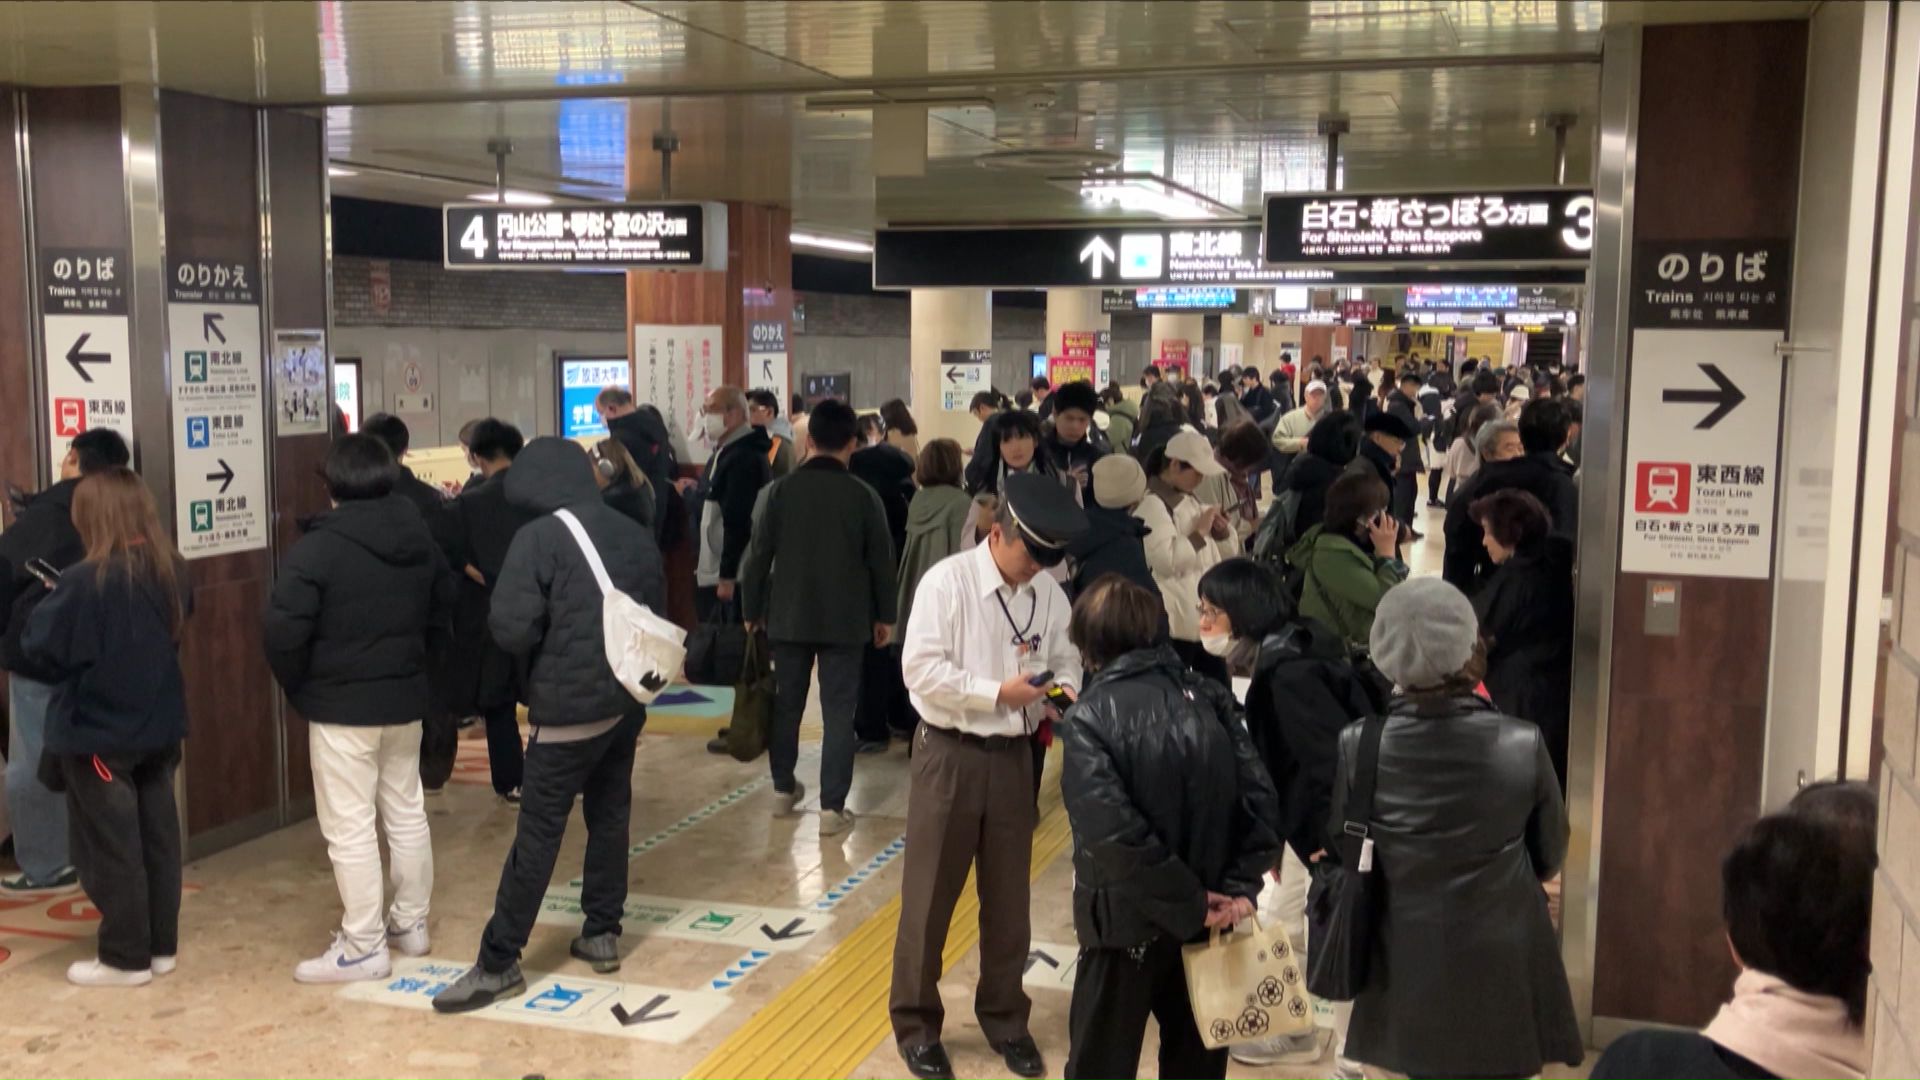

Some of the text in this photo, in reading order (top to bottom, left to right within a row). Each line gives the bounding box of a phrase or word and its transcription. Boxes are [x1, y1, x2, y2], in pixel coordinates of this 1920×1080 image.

[1302, 198, 1549, 230] 白石・新さっぽろ方面
[1562, 196, 1593, 250] 3
[460, 214, 489, 259] 4
[1170, 231, 1242, 256] 南北線
[1301, 228, 1483, 245] For Shiroishi, Shin Sapporo
[53, 257, 114, 281] のりば
[1170, 258, 1224, 270] Namboku
[1658, 251, 1768, 283] のりば
[178, 263, 248, 288] のりかえ
[48, 285, 76, 297] Trains
[1645, 289, 1694, 303] Trains
[753, 324, 783, 342] のりかえ
[210, 351, 242, 366] 南北線
[88, 399, 126, 415] 東西線
[212, 415, 243, 430] 東豊線
[1696, 464, 1765, 485] 東西線
[1696, 487, 1753, 498] Tozai Line
[215, 496, 247, 513] 南北線
